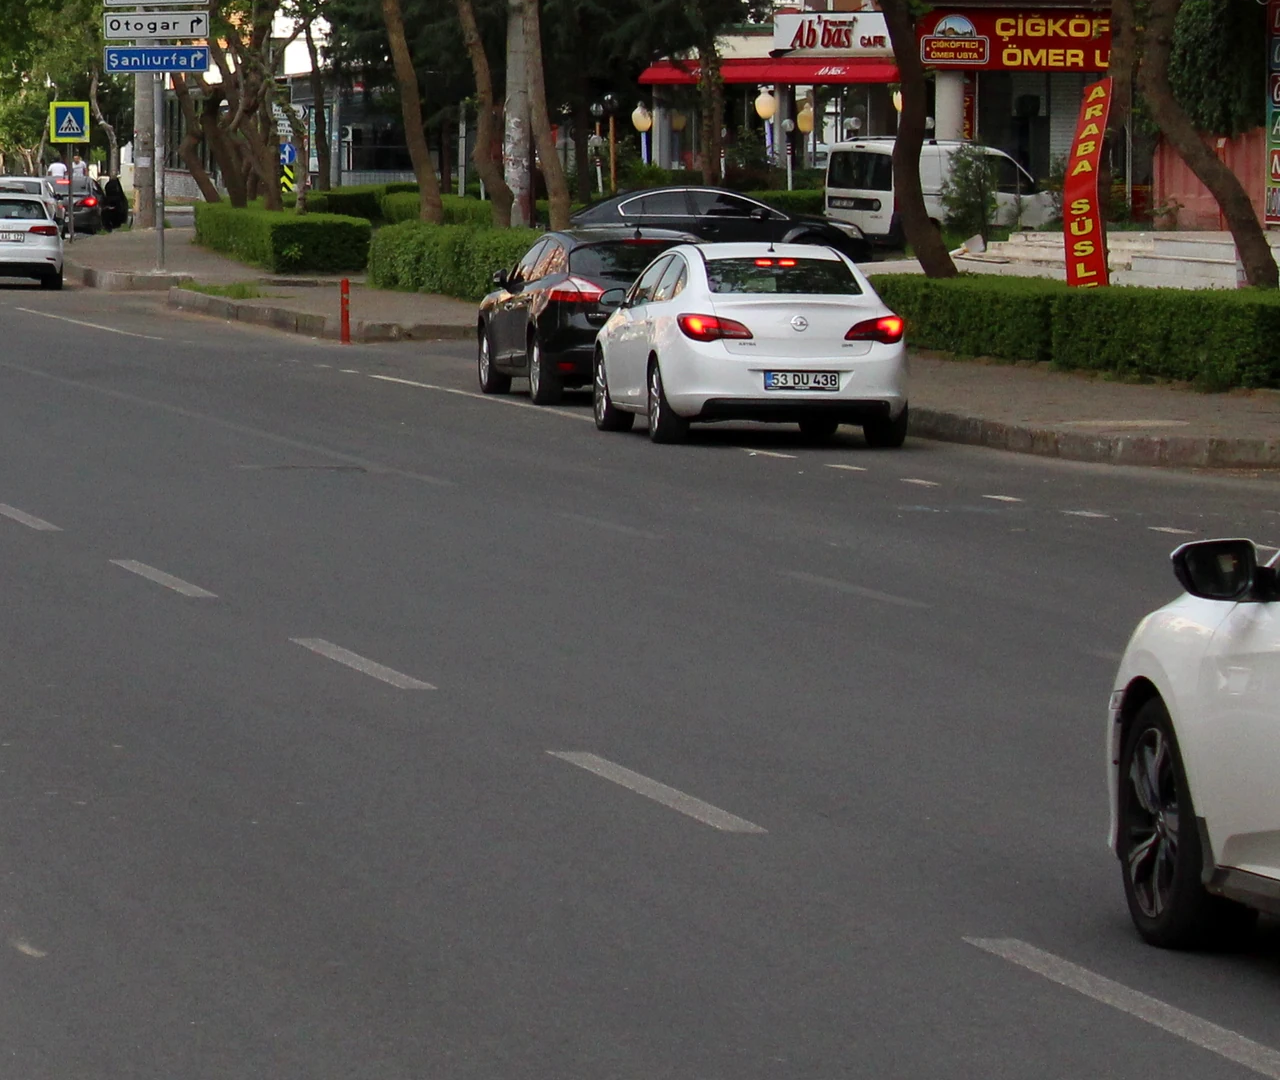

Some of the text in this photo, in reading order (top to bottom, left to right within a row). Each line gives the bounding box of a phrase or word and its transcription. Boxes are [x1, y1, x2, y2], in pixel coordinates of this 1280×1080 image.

[109, 19, 180, 34] Otogar
[995, 13, 1110, 42] ÇİĞKÖF
[859, 35, 886, 48] CAFE
[109, 52, 188, 68] Şanlıurfa
[930, 51, 979, 59] ÖMER USTA
[1002, 44, 1084, 67] ÖMER
[1071, 86, 1107, 177] ARABA
[771, 373, 837, 386] 53 DU 438
